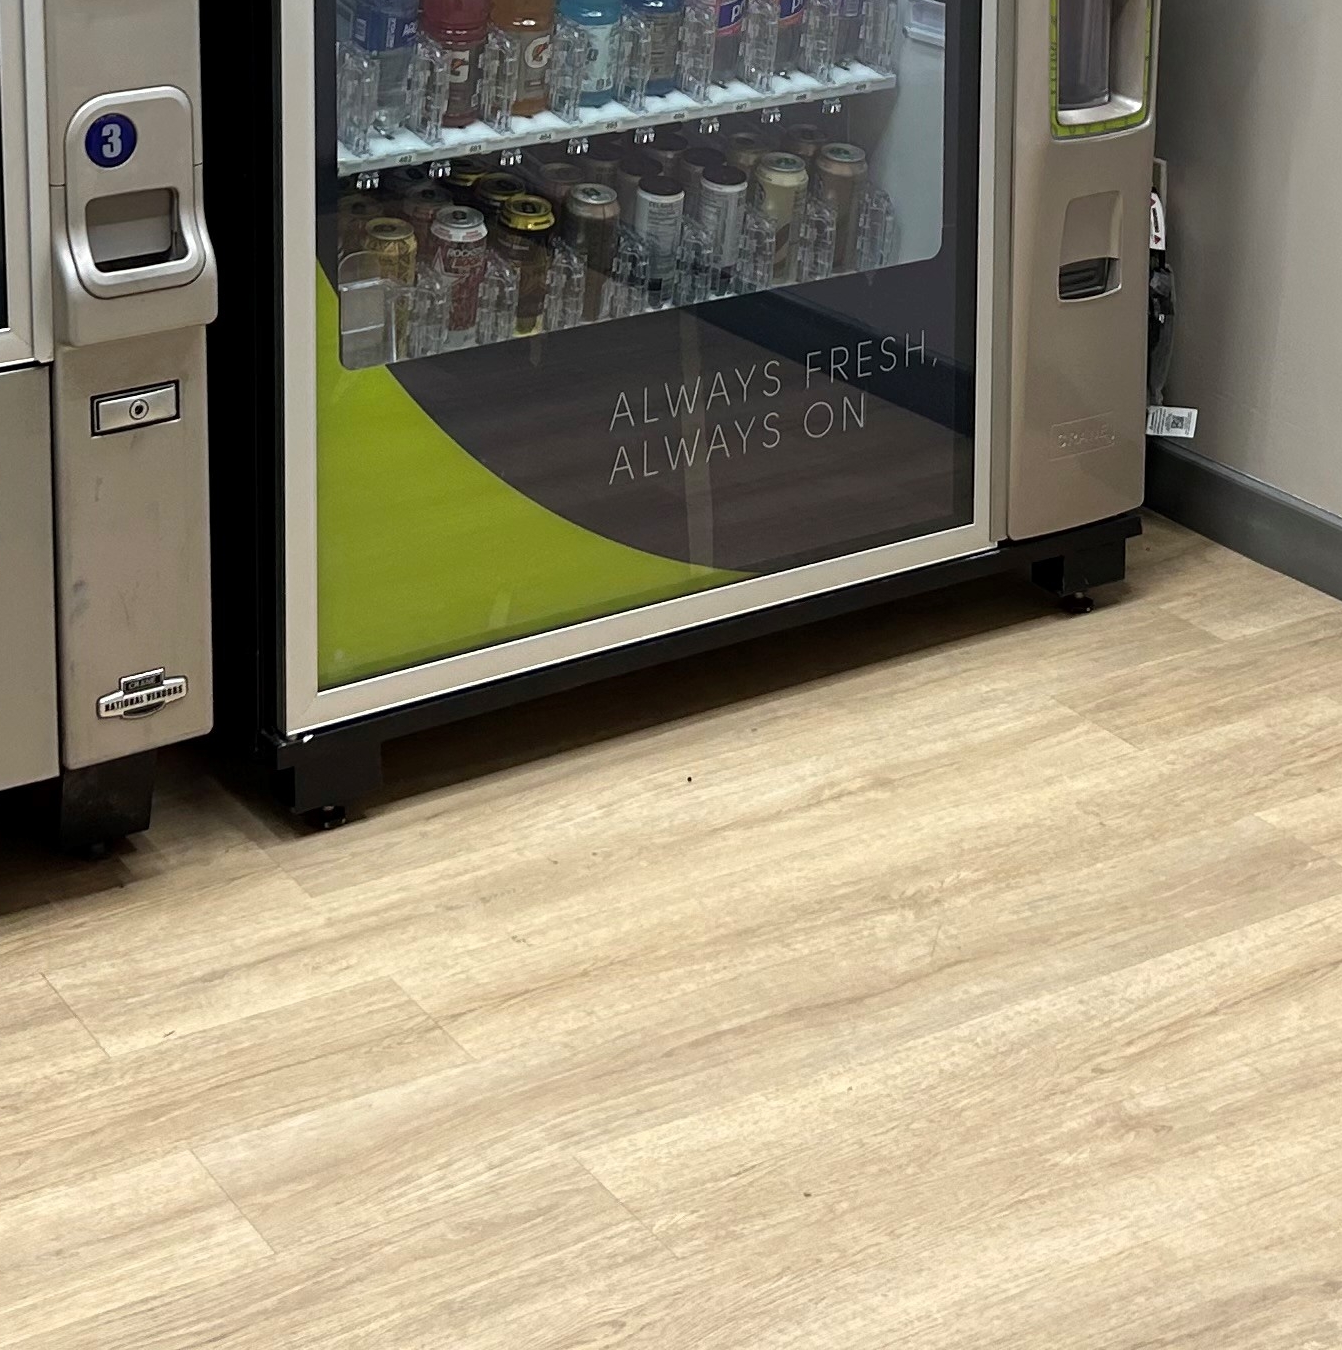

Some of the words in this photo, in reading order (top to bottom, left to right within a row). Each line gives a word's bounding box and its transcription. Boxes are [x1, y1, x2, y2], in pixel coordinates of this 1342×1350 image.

[450, 50, 470, 84] G
[524, 34, 551, 68] G
[101, 122, 123, 159] 3
[610, 359, 781, 432] ALWAYS
[806, 329, 938, 390] FRESH,
[609, 411, 781, 486] ALWAYS
[803, 392, 866, 439] ON
[104, 694, 145, 712] NATIONAL
